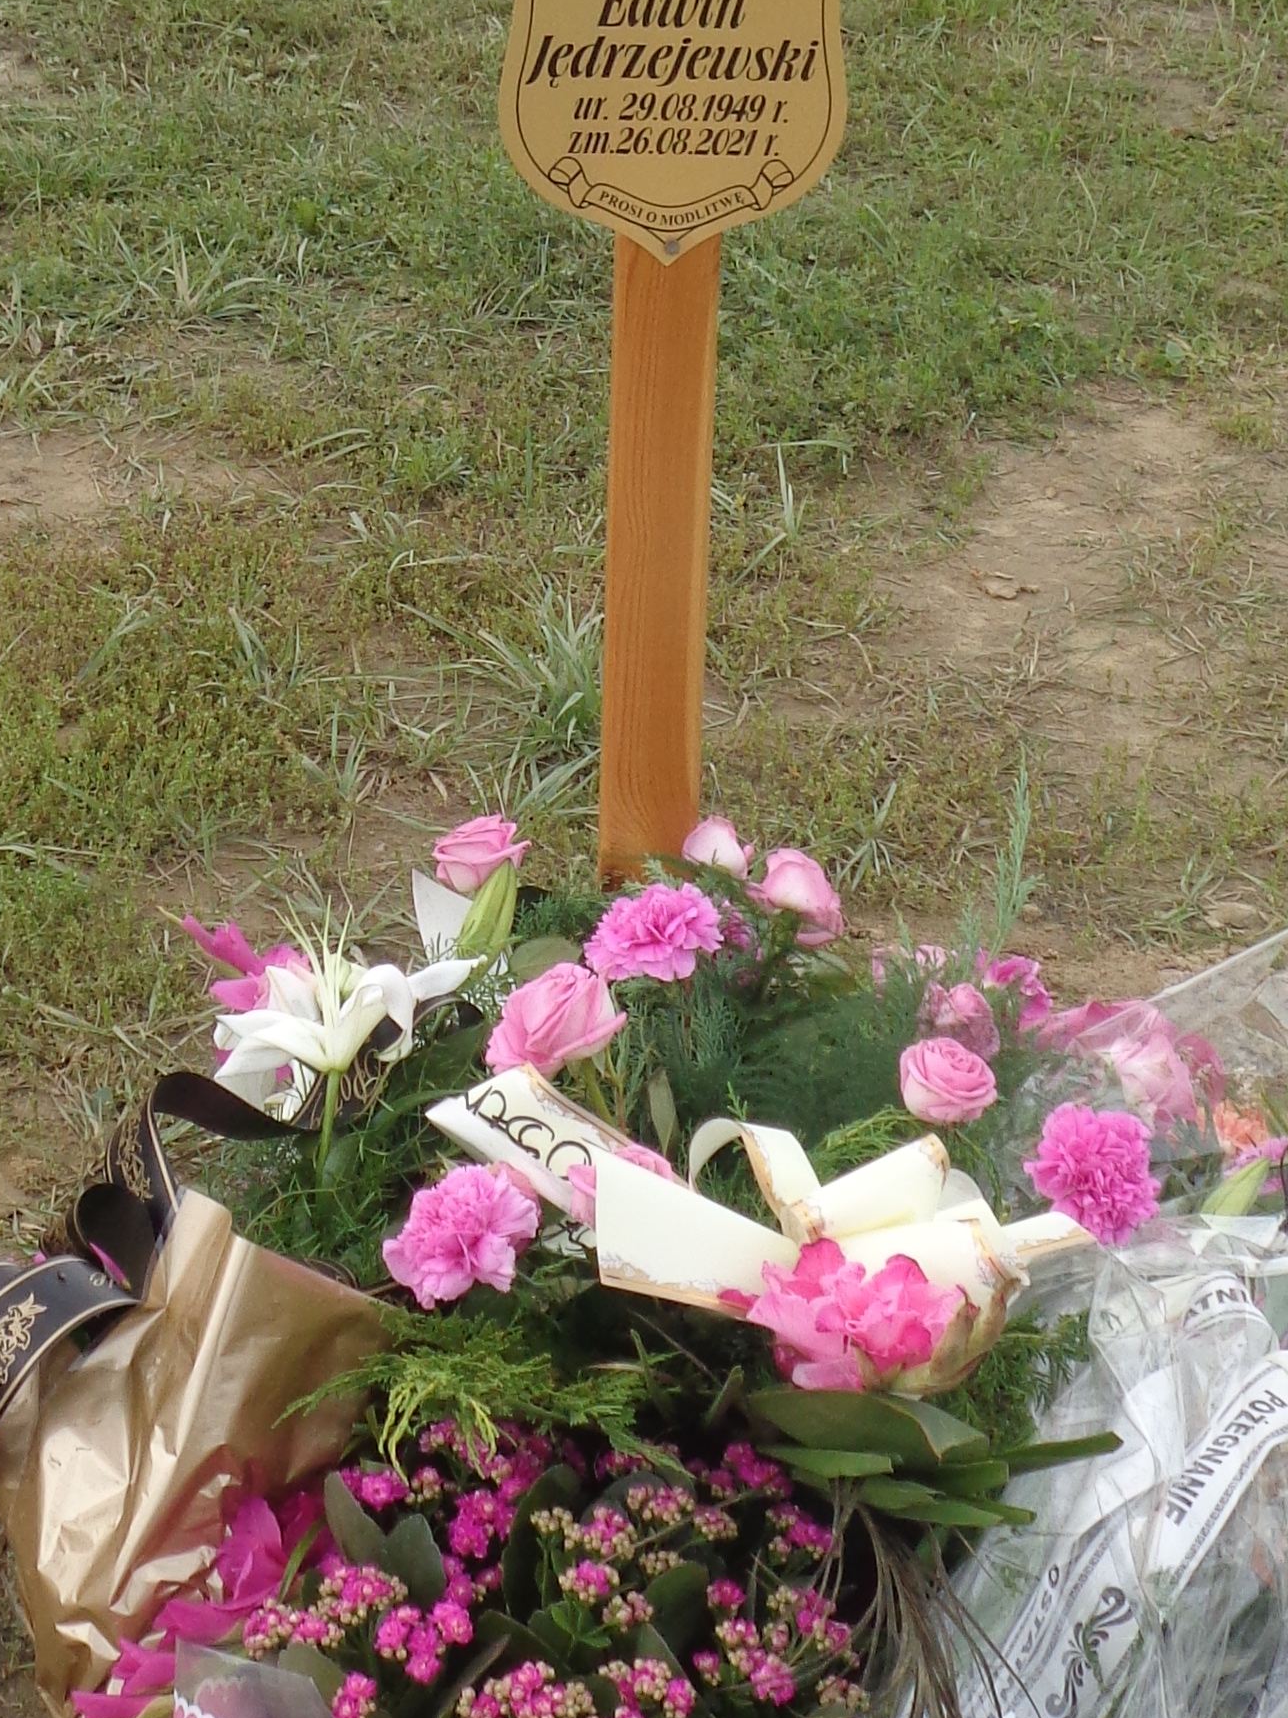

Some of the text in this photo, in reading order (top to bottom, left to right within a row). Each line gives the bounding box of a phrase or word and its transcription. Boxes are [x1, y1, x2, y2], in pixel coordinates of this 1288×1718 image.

[525, 35, 819, 88] Jędrzejewski
[573, 92, 789, 124] ur. 29.08.1949 r.
[763, 134, 780, 157] r.
[599, 190, 745, 226] PROSI O MODLITWĘ
